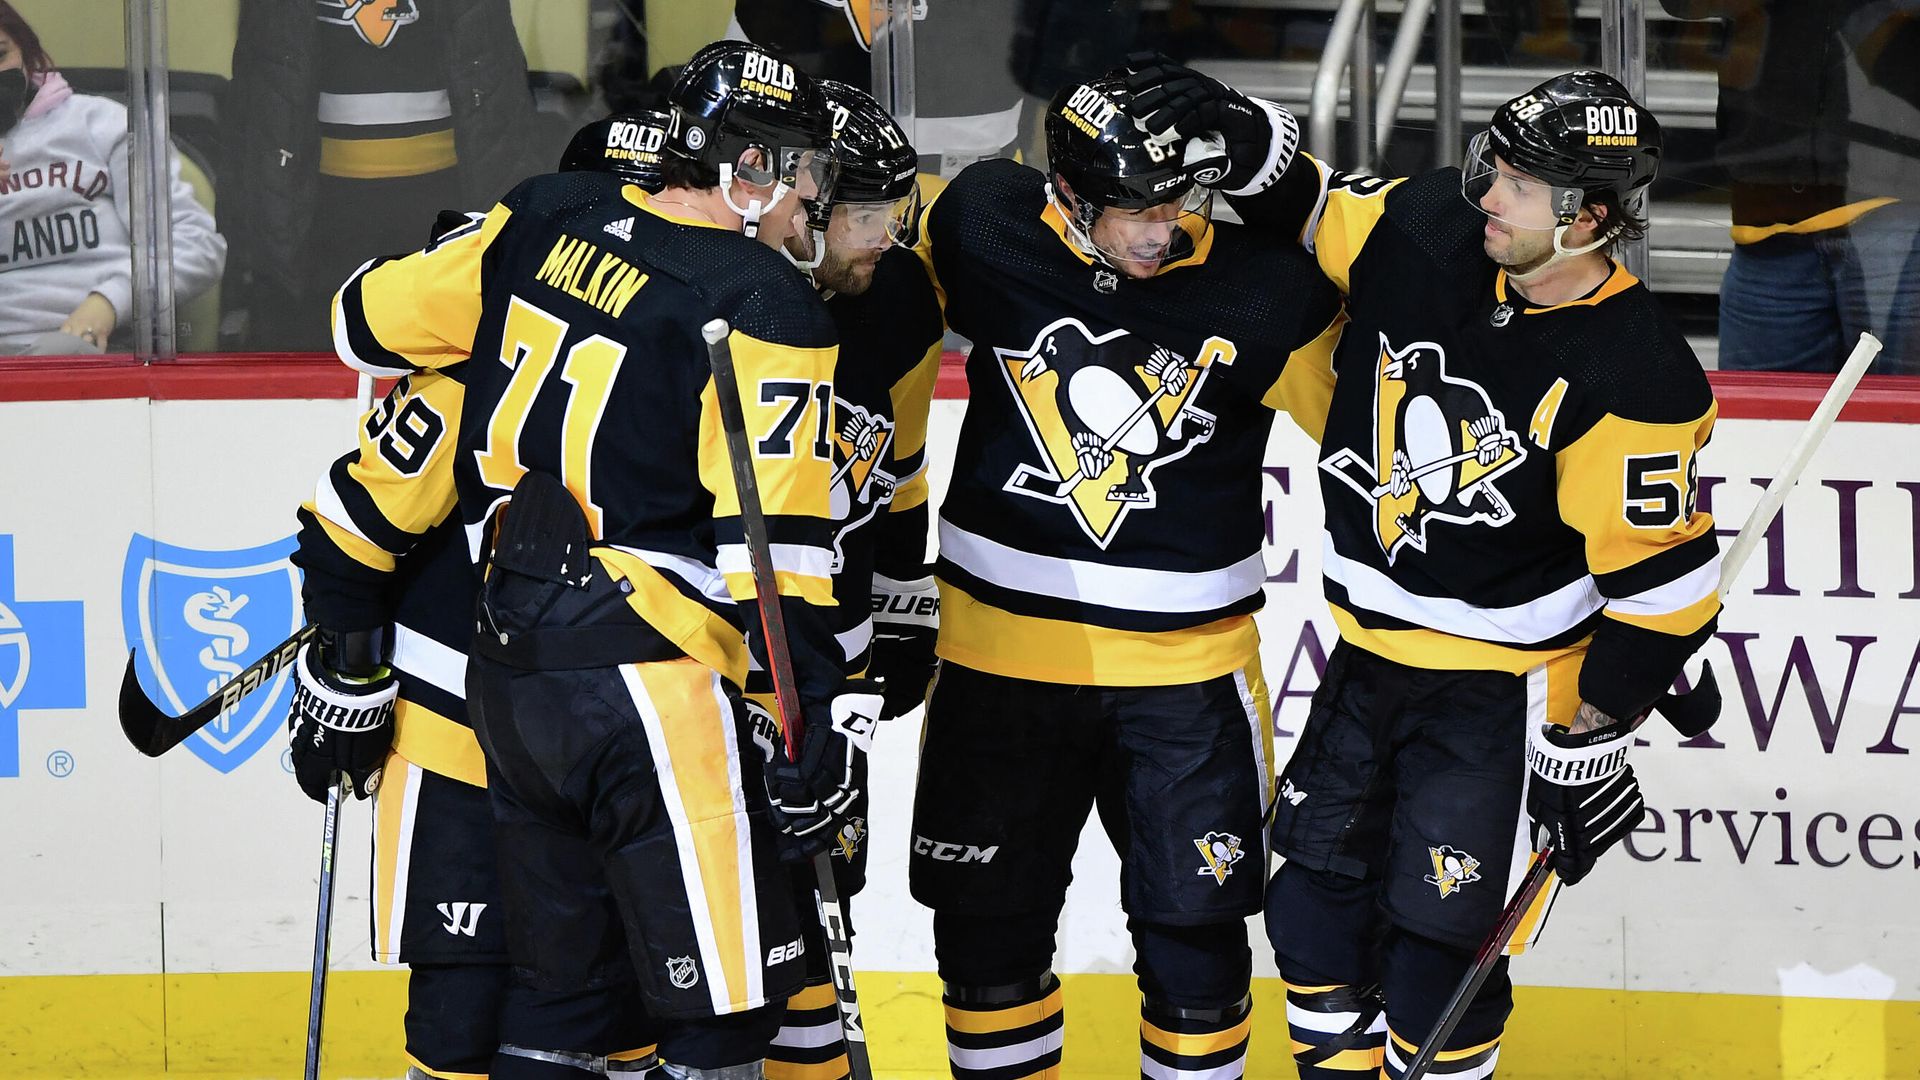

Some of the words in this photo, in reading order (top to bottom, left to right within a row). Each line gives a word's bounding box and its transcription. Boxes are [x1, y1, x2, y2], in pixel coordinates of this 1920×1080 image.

[742, 51, 795, 90] BOLD
[740, 79, 792, 102] PENGUIN
[1067, 85, 1117, 129] BOLD
[1061, 106, 1100, 139] PENGUIN
[1510, 95, 1544, 120] 58
[1585, 105, 1638, 135] BOLD
[607, 121, 663, 152] BOLD
[1587, 135, 1638, 146] PENGUIN
[605, 148, 660, 163] PENGUIN
[1153, 173, 1187, 192] CCM
[603, 224, 632, 242] adidas
[535, 234, 650, 319] MALKIN
[473, 294, 628, 540] 71
[755, 378, 834, 461] 71
[1529, 377, 1569, 450] A
[299, 684, 394, 729] ARRIOR
[1622, 787, 1920, 869] ervice
[914, 834, 1000, 863] CCM
[822, 901, 865, 1042] CCM
